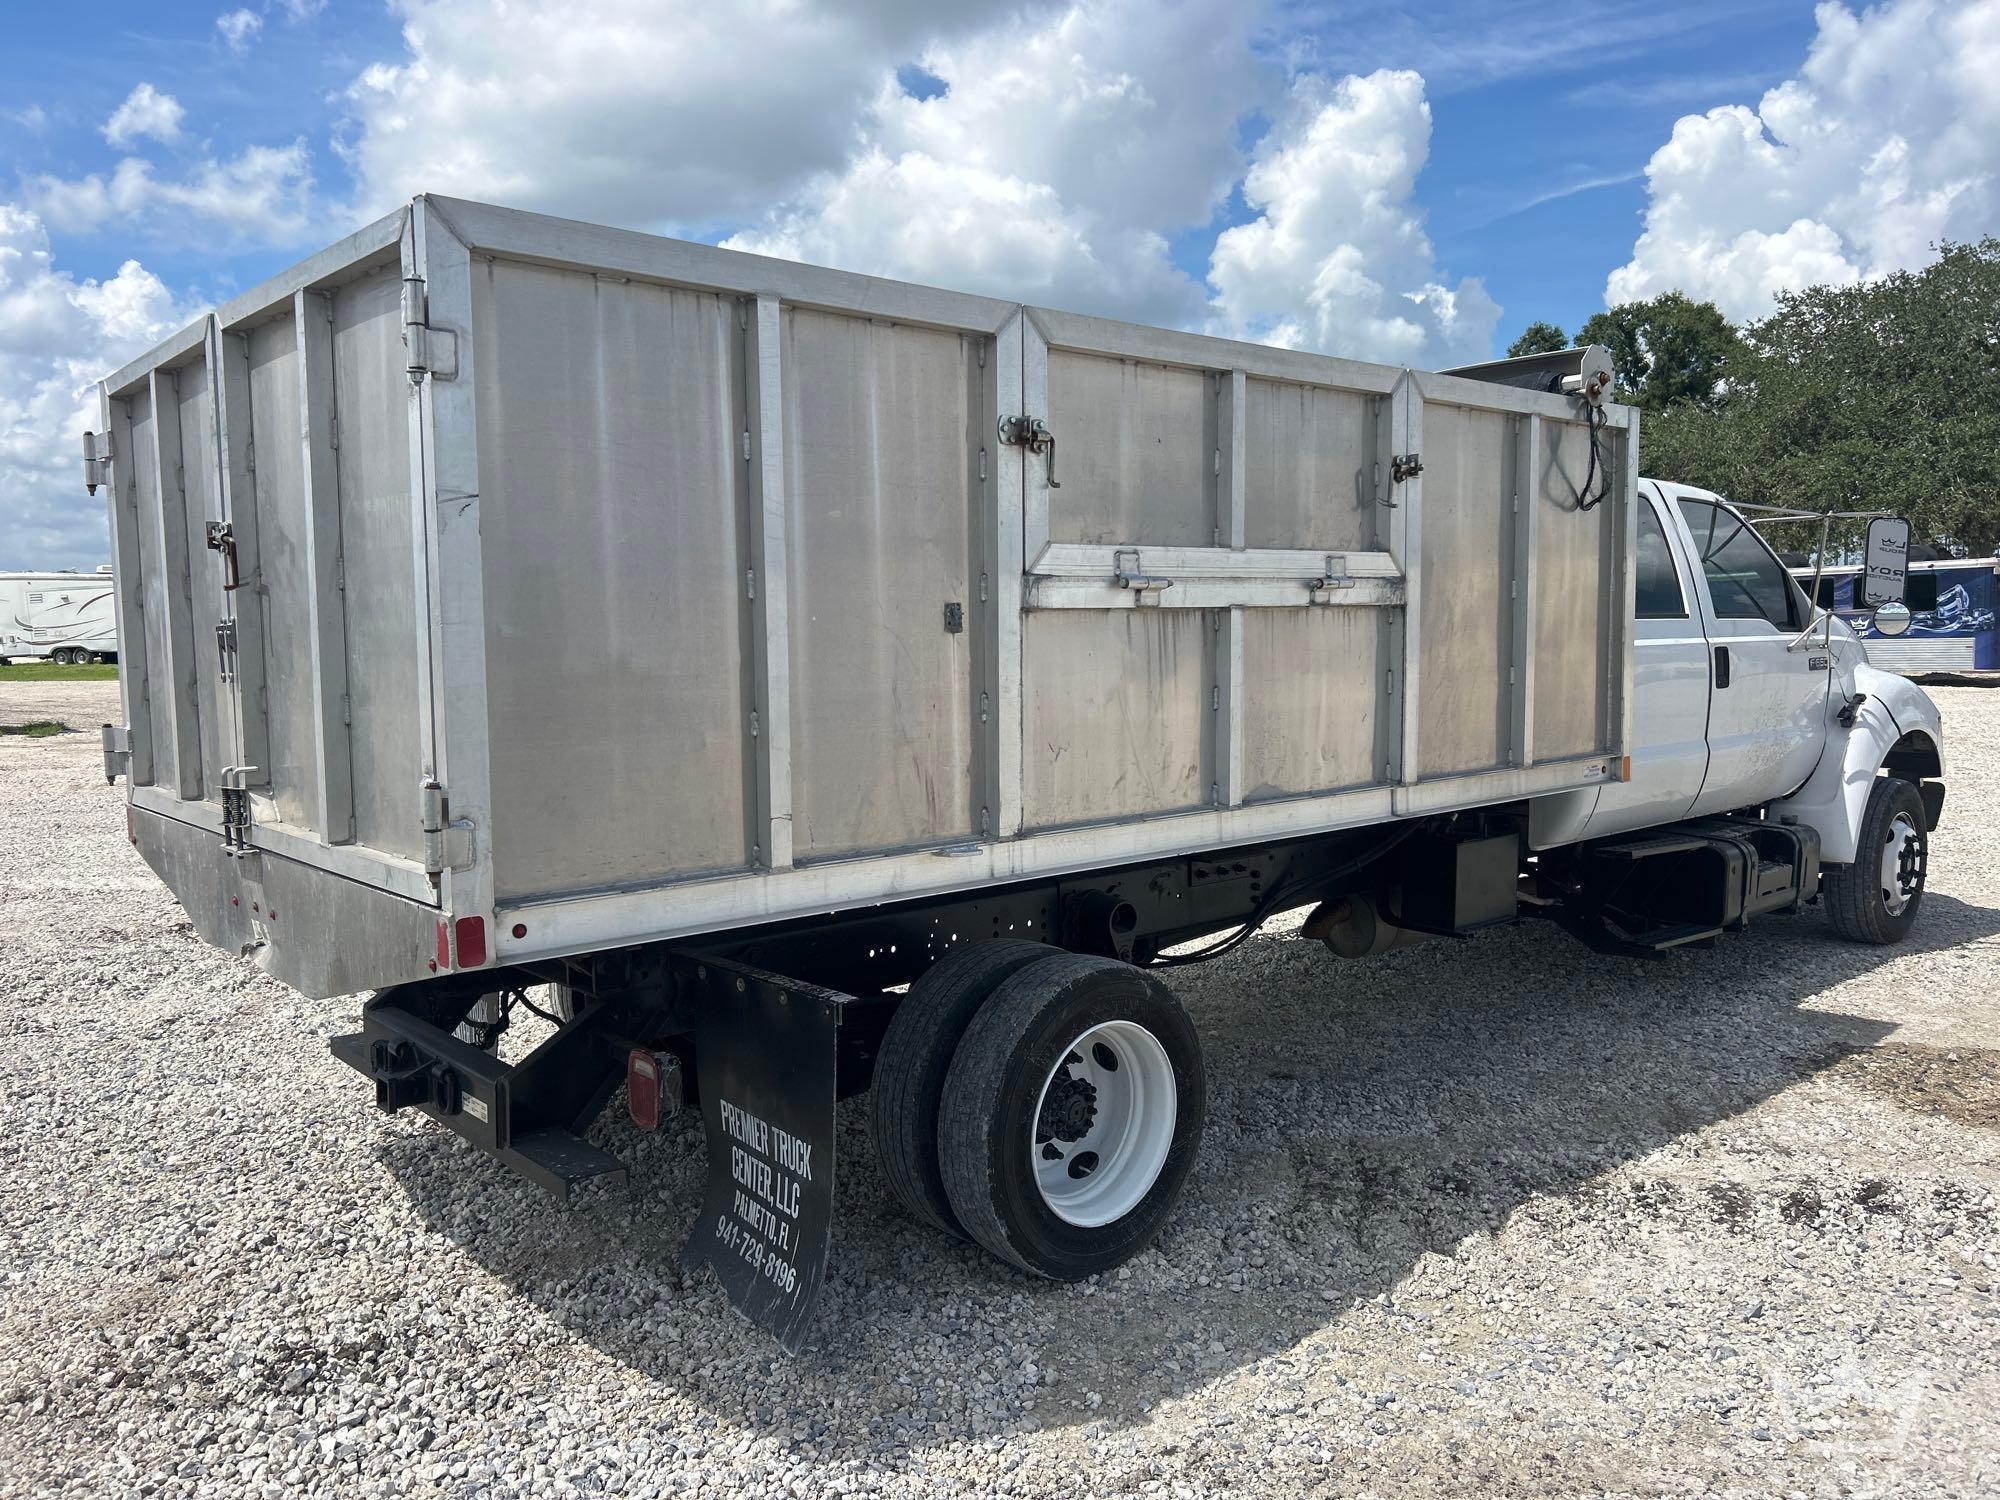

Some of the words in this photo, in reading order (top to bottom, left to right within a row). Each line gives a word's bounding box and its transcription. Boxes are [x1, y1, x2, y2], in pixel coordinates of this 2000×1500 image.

[720, 1098, 769, 1156] PREMIER
[771, 1126, 812, 1181] TRUCK
[731, 1145, 774, 1207] CENTER,
[776, 1172, 800, 1219] LLC
[733, 1189, 777, 1246] PALMETTO,
[778, 1220, 789, 1251] FL
[715, 1214, 797, 1293] 941-729-8196
